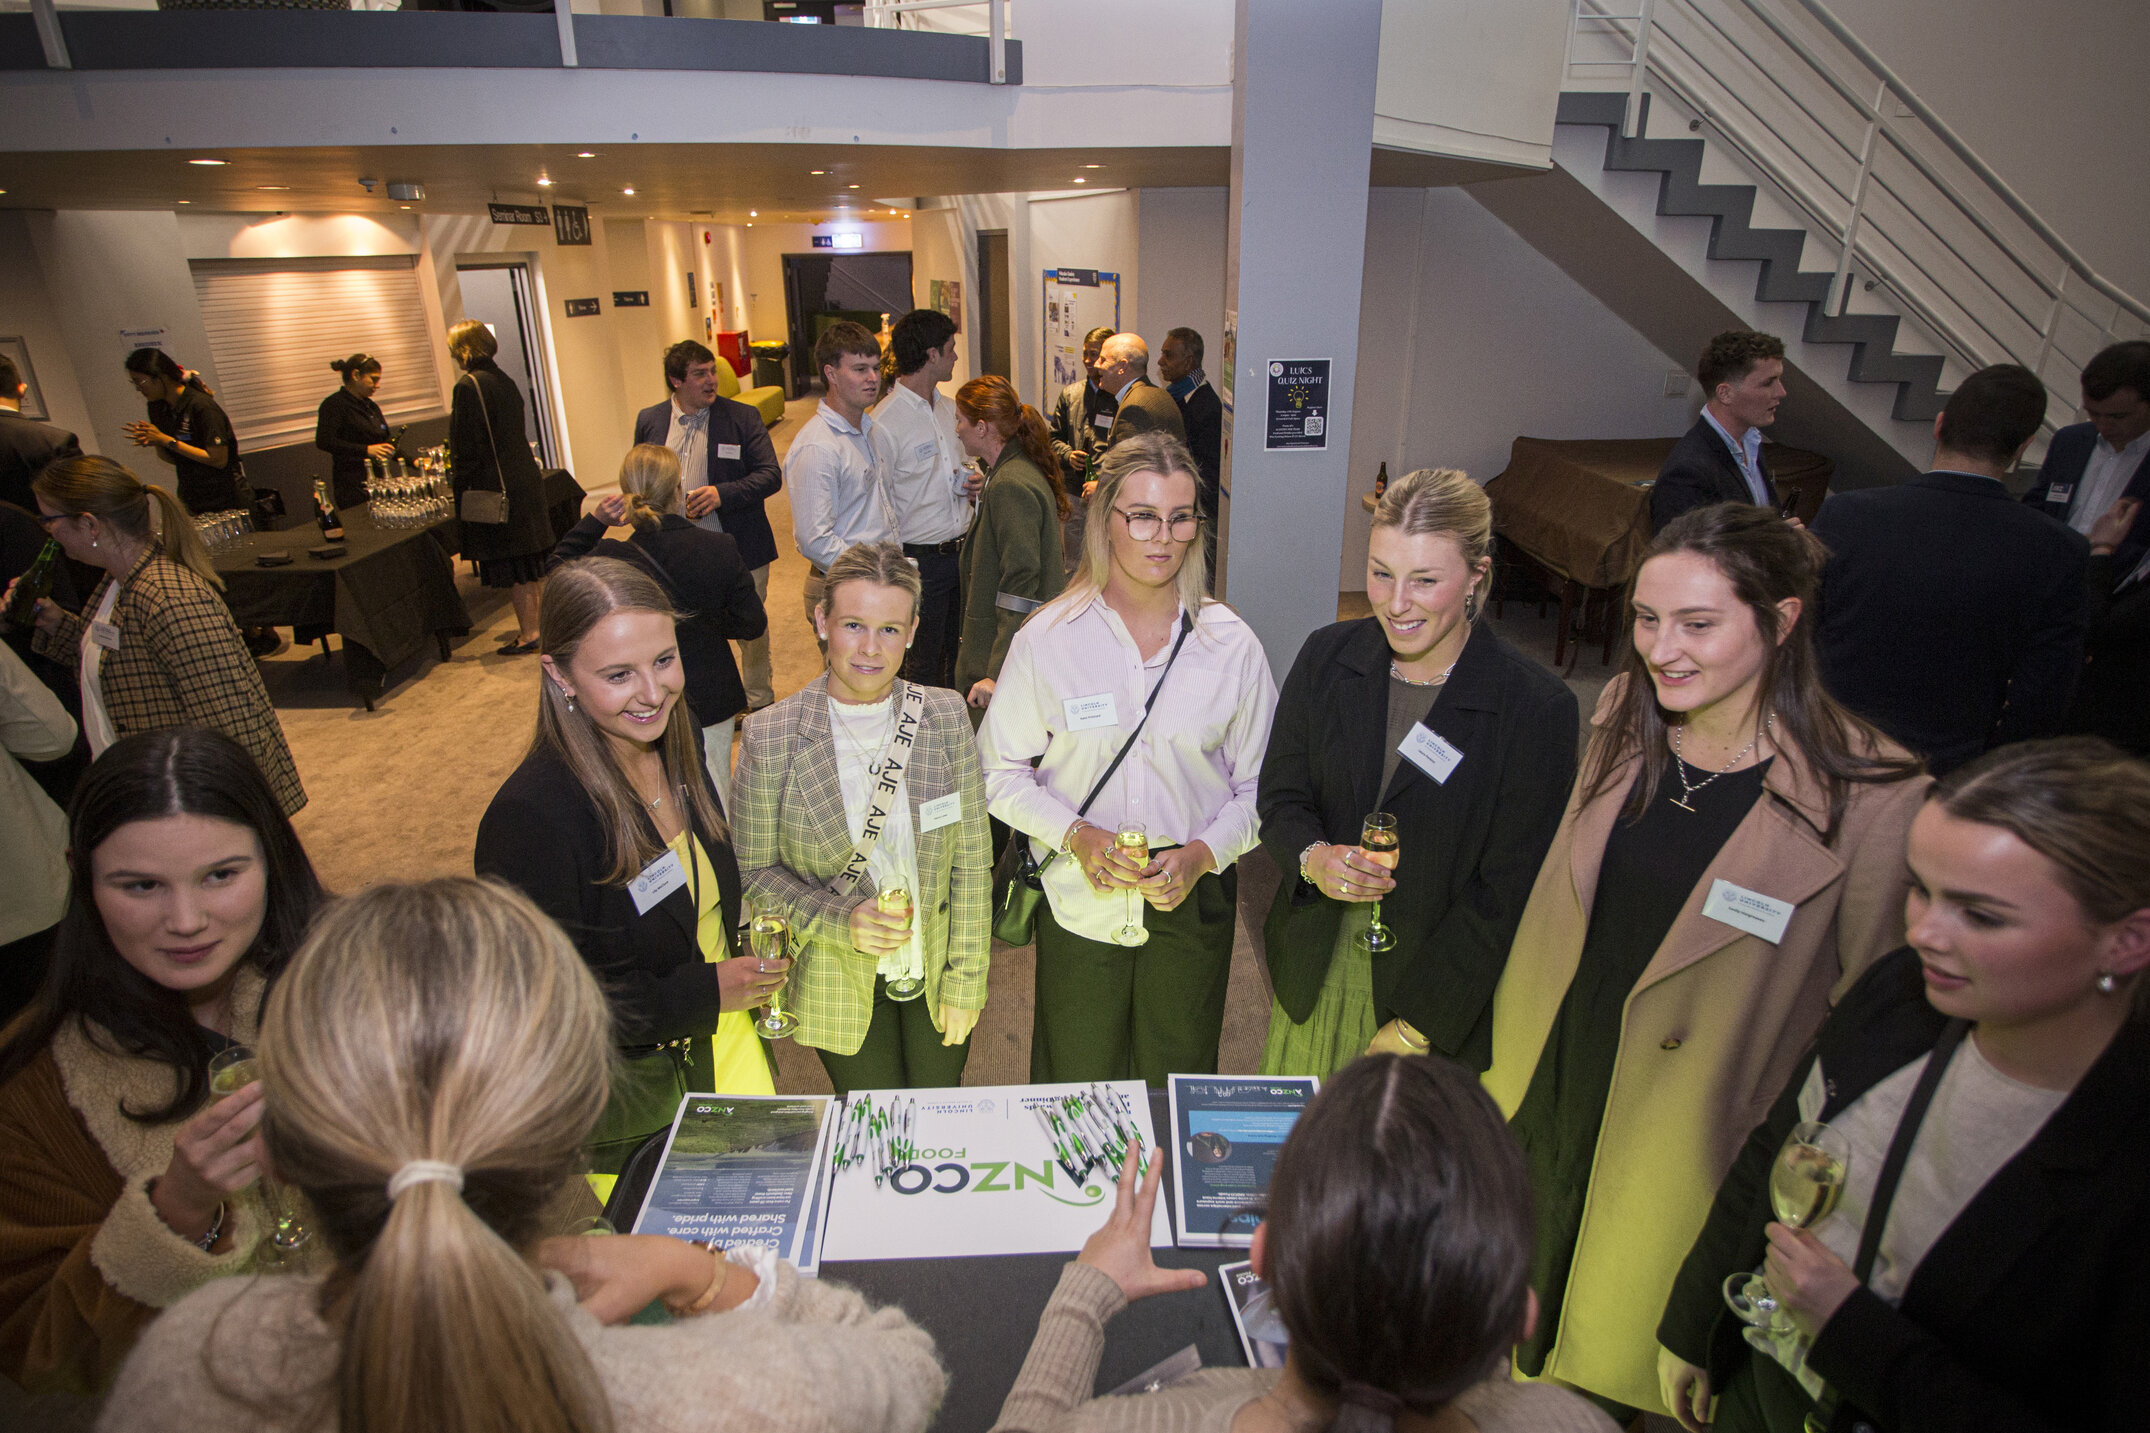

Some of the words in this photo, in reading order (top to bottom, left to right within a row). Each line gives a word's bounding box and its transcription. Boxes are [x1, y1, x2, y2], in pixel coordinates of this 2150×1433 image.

[491, 207, 515, 221] Seminar
[515, 210, 532, 222] Room
[1278, 377, 1297, 385] QUIZ
[1299, 376, 1323, 384] NIGHT
[905, 683, 923, 705] JE
[894, 712, 917, 748] AJE
[1426, 742, 1451, 761] UNIVERSITY
[1427, 739, 1446, 753] LINCOLN
[878, 756, 904, 795] AJE
[862, 805, 887, 842] AJE
[647, 866, 666, 880] LINCOLN
[648, 864, 674, 883] UNIVERSITY
[840, 851, 868, 884] AJE
[1739, 898, 1781, 915] UNIVERSITY
[1740, 895, 1769, 907] LINCOLN
[1269, 1088, 1302, 1096] ANZCO
[1020, 1096, 1054, 1104] Dinner
[696, 1106, 735, 1115] ANZCO
[672, 1212, 709, 1225] pride.
[709, 1214, 738, 1225] with
[739, 1213, 787, 1225] Shared
[667, 1226, 699, 1235] care.
[701, 1226, 729, 1237] with
[731, 1226, 783, 1237] Crafted
[723, 1238, 780, 1250] Created
